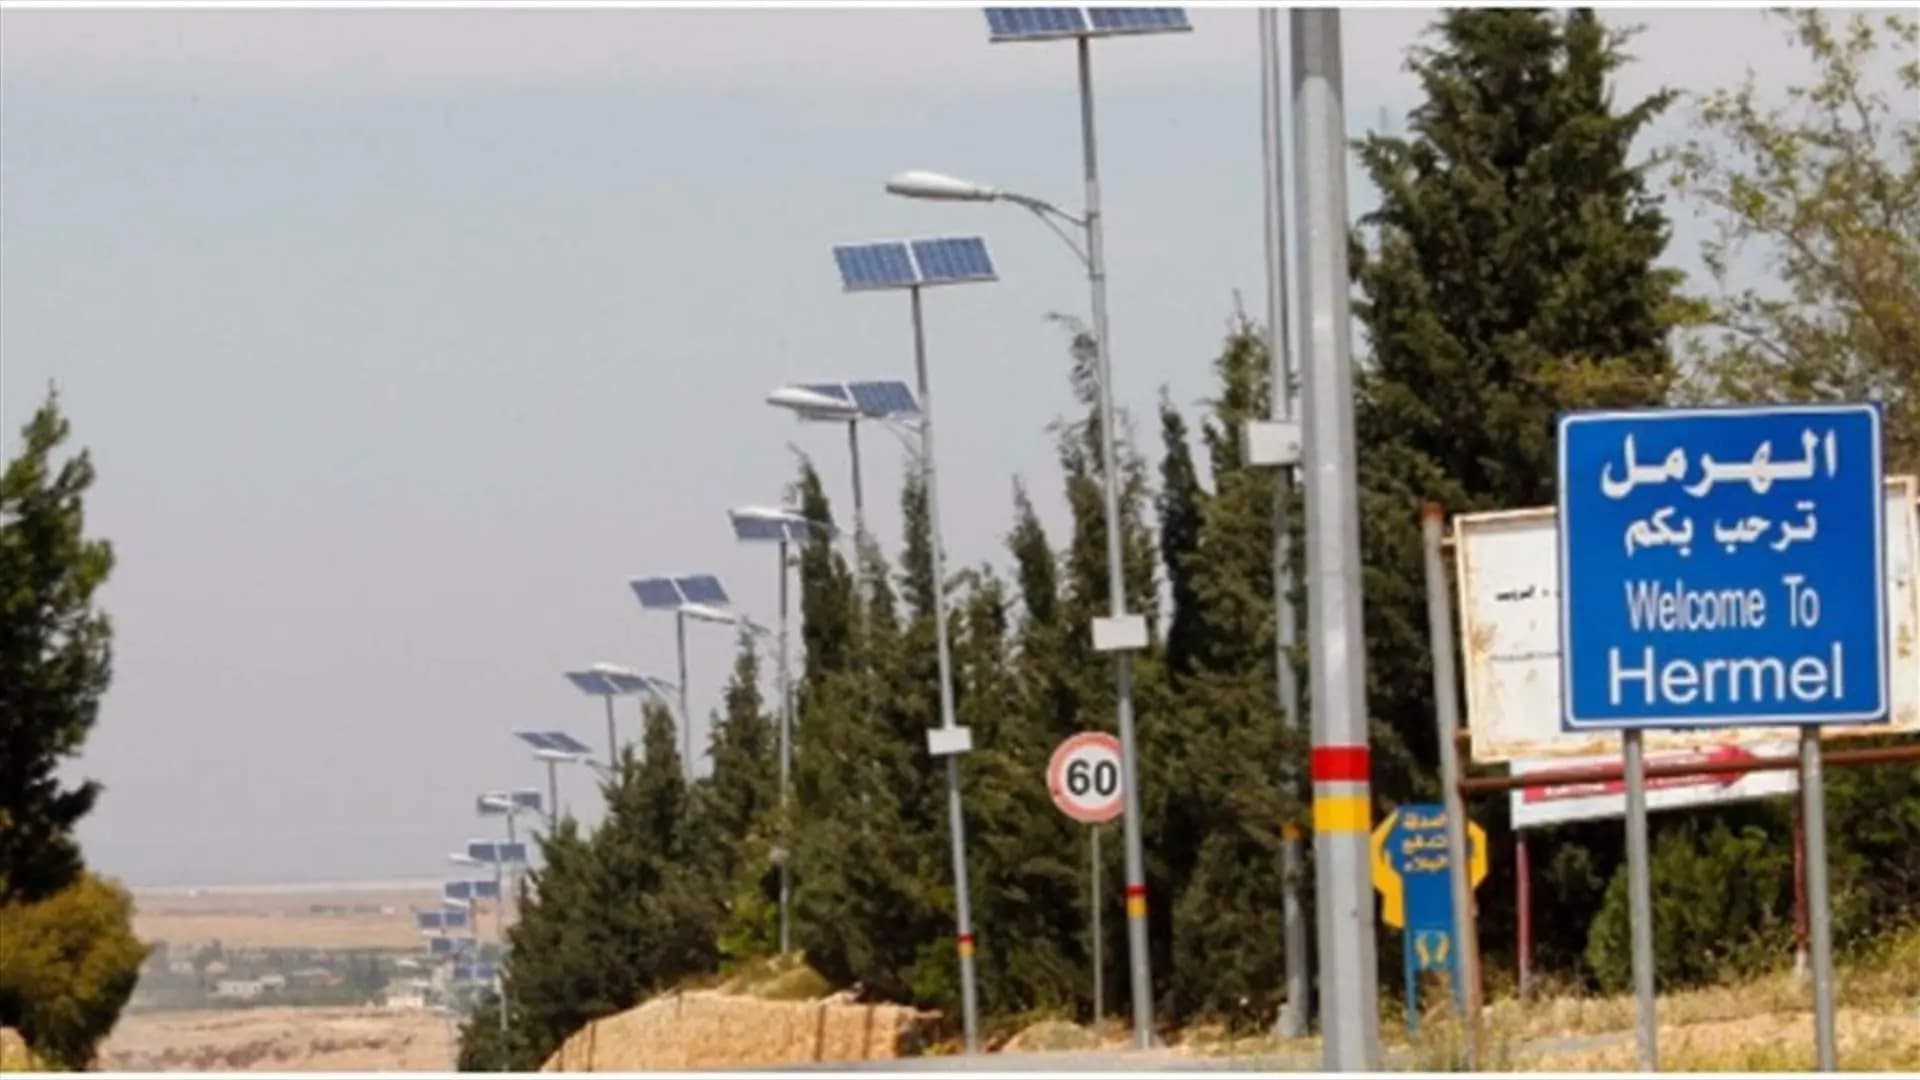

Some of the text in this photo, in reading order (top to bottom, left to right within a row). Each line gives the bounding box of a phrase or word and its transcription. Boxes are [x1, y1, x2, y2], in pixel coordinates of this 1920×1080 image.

[1601, 429, 1838, 500] الهرمل
[1625, 502, 1817, 557] ترحب بكم
[1625, 574, 1820, 631] Welcome To
[1609, 641, 1843, 705] Hermel
[1067, 759, 1118, 797] 60
